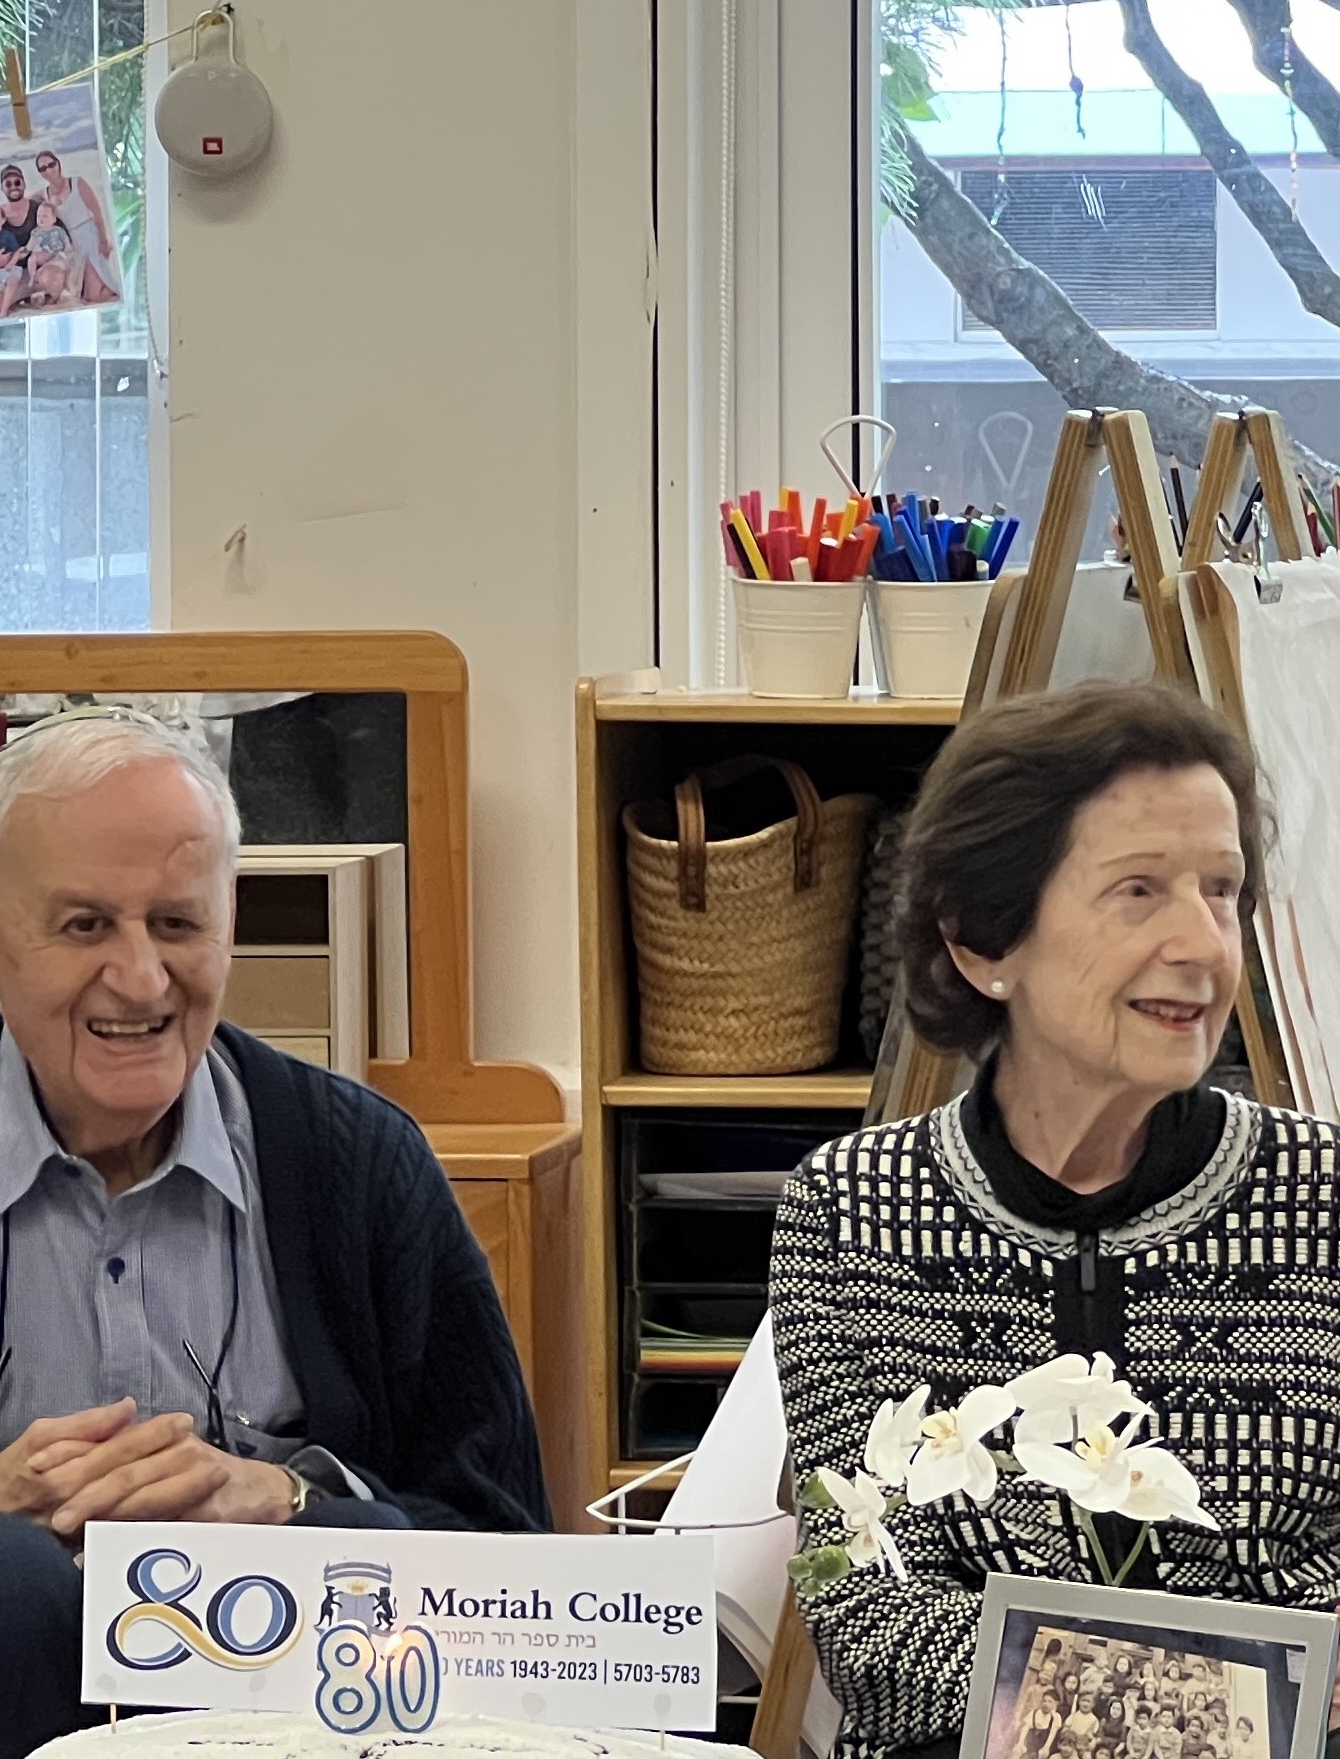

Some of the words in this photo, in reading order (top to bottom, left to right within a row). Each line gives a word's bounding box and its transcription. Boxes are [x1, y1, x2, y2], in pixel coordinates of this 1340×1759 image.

[106, 1548, 304, 1671] 80
[417, 1587, 553, 1619] Moriah
[568, 1591, 703, 1634] College
[435, 1629, 485, 1645] המורי
[490, 1631, 515, 1646] הר
[520, 1632, 560, 1647] ספר
[564, 1633, 597, 1648] בית
[315, 1622, 441, 1734] 80
[454, 1657, 505, 1678] YEARS
[510, 1659, 597, 1681] 1943-2023
[613, 1662, 700, 1685] 5703-5783
